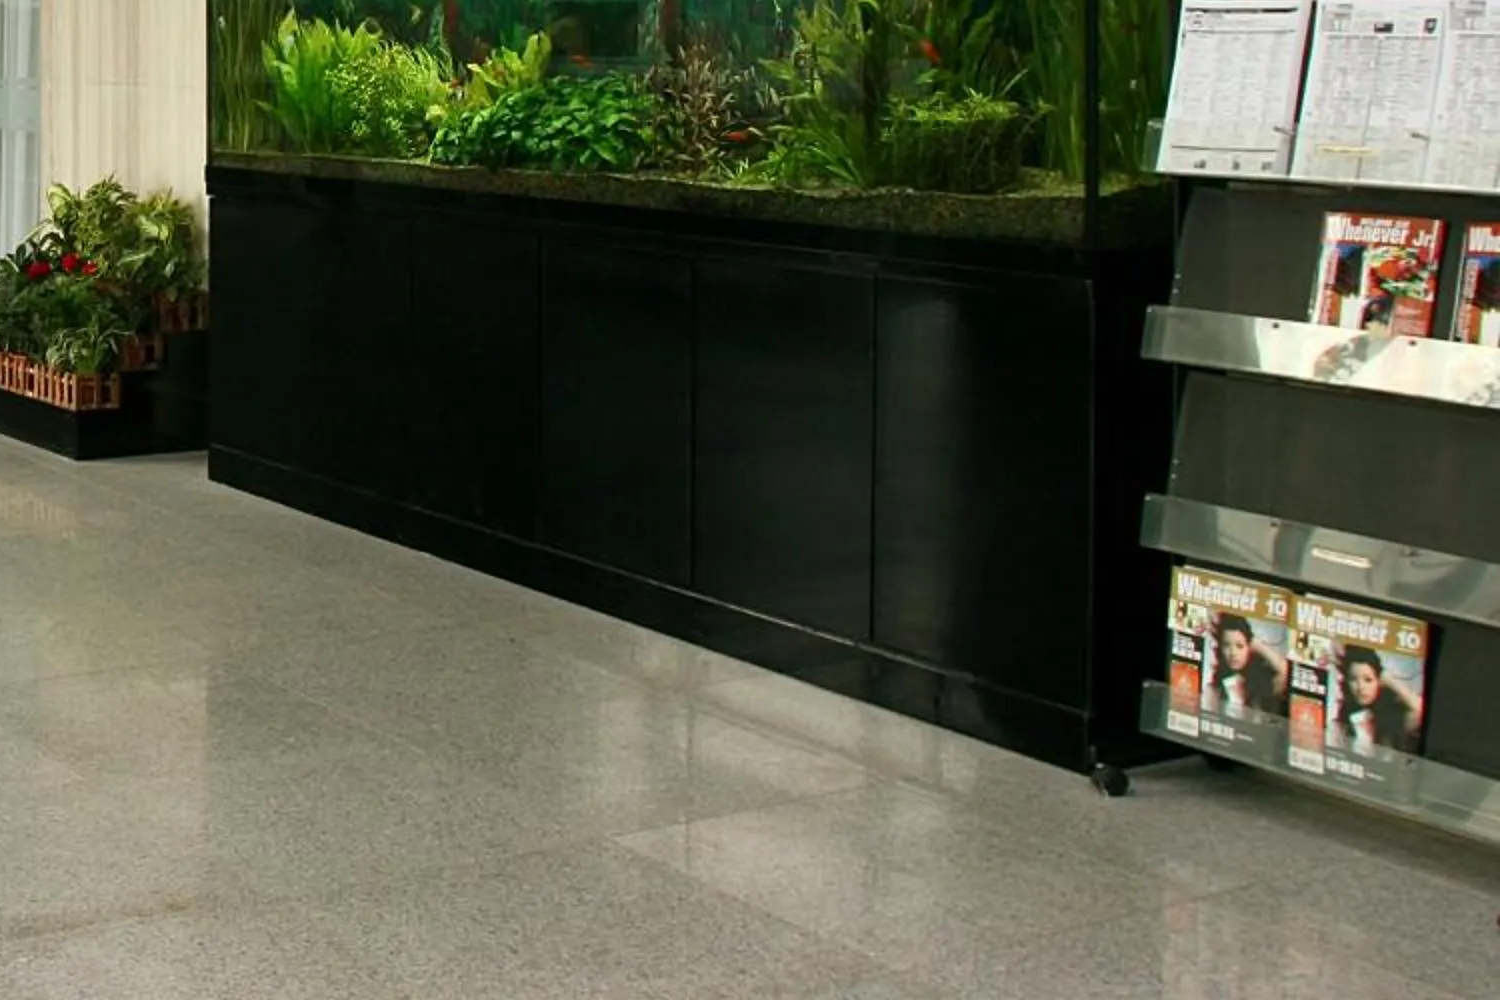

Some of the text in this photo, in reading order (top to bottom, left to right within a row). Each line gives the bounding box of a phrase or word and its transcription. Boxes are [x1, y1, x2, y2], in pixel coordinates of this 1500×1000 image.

[1326, 215, 1410, 246] Whenever
[1177, 572, 1257, 613] Whenever
[1264, 599, 1287, 618] 10
[1297, 601, 1388, 644] Whenever
[1396, 630, 1420, 649] 10
